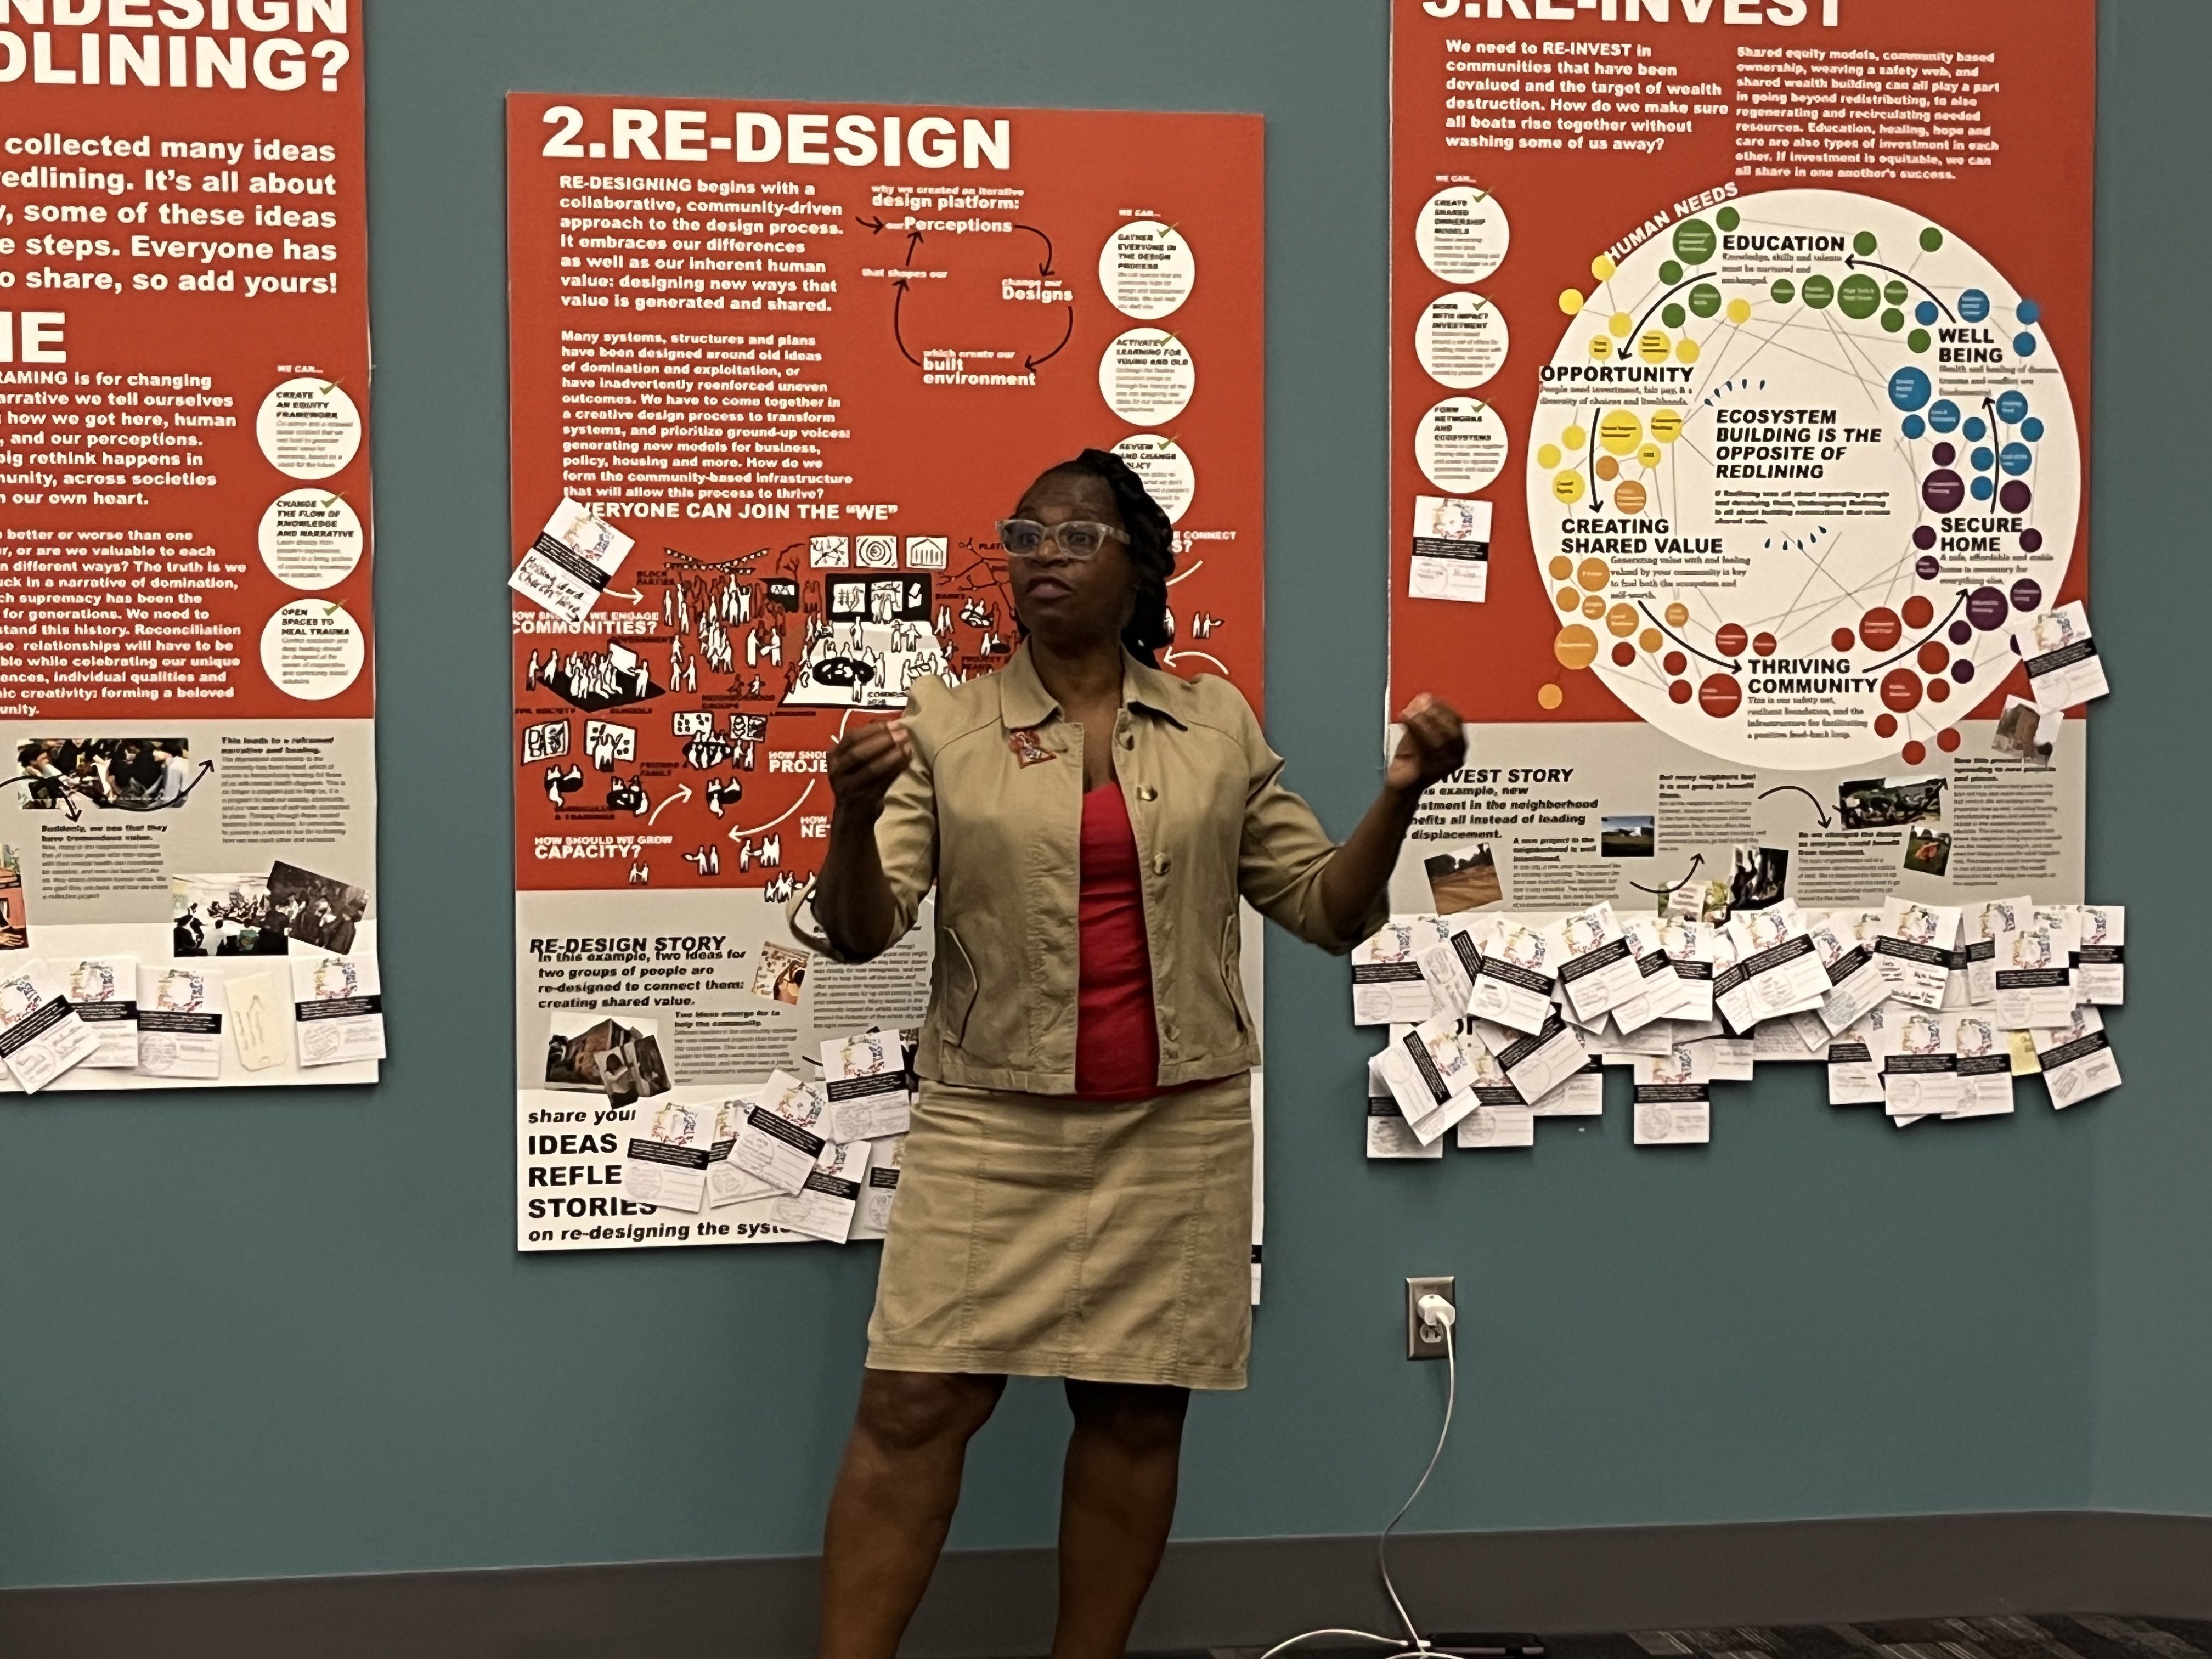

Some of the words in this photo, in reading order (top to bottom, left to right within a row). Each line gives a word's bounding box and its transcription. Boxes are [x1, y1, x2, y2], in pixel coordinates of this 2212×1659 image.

[1446, 39, 1471, 53] We
[1476, 41, 1516, 54] need
[1521, 42, 1538, 54] to
[1543, 41, 1632, 57] RE-INVEST
[1637, 44, 1651, 57] in
[542, 106, 1011, 170] 2.RE-DESIGN
[1967, 126, 1991, 136] and
[5, 133, 150, 157] collected
[161, 142, 244, 165] many
[253, 138, 336, 162] ideas
[1445, 134, 1514, 151] washing
[1519, 138, 1562, 149] some
[1567, 136, 1584, 149] of
[1589, 139, 1608, 150] us
[1612, 137, 1664, 154] away?
[145, 169, 192, 191] It's
[202, 170, 238, 193] all
[249, 172, 336, 195] about
[560, 175, 692, 192] RE-DESIGNING
[697, 179, 756, 196] begins
[760, 180, 799, 195] with
[804, 184, 815, 195] a
[560, 195, 681, 214] collaborative,
[686, 200, 843, 217] community-driven
[872, 194, 933, 212] design
[938, 194, 1019, 211] platform:
[1673, 181, 1739, 218] NEEDS
[24, 205, 108, 223] some
[117, 202, 149, 223] of
[158, 203, 245, 226] these
[255, 205, 337, 228] ideas
[560, 216, 643, 232] approach
[648, 217, 667, 230] to
[672, 217, 701, 232] the
[706, 218, 764, 236] design
[769, 223, 844, 236] process.
[904, 216, 1013, 234] Perceptions
[25, 233, 120, 261] steps.
[131, 235, 273, 263] Everyone
[284, 238, 337, 261] has
[1723, 235, 1845, 251] EDUCATION
[26, 266, 122, 295] share,
[132, 273, 168, 291] so
[178, 270, 234, 292] add
[244, 272, 337, 297] yours!
[561, 293, 609, 307] value
[614, 294, 630, 307] is
[635, 296, 725, 311] generated
[730, 296, 762, 310] and
[767, 297, 832, 312] shared.
[1002, 286, 1074, 304] Designs
[1938, 328, 1994, 344] WELL
[1939, 347, 2003, 363] BEING
[923, 358, 964, 371] built
[923, 372, 1036, 386] environment
[1540, 365, 1695, 383] OPPORTUNITY
[75, 394, 102, 405] we
[108, 392, 138, 406] tell
[143, 393, 233, 407] ourselves
[7, 410, 47, 425] how
[52, 414, 80, 425] we
[84, 412, 116, 428] got
[121, 411, 169, 429] here,
[174, 412, 236, 427] human
[1716, 409, 1837, 425] ECOSYSTEM
[10, 430, 44, 444] and
[50, 434, 82, 444] our
[87, 432, 203, 448] perceptions.
[630, 425, 656, 436] and
[727, 427, 798, 440] ground-up
[1716, 427, 1811, 443] BUILDING
[1818, 428, 1837, 443] IS
[1843, 428, 1882, 443] THE
[1716, 446, 1815, 461] OPPOSITE
[1821, 446, 1847, 461] OF
[63, 474, 126, 485] across
[132, 472, 217, 486] societies
[1716, 464, 1824, 479] REDLINING
[12, 494, 44, 504] our
[48, 494, 87, 505] own
[93, 491, 149, 505] heart.
[686, 503, 731, 518] CAN
[738, 503, 790, 519] JOIN
[796, 504, 840, 520] THE
[1561, 518, 1669, 534] CREATING
[1940, 517, 2023, 533] SECURE
[7, 528, 54, 540] better
[57, 531, 74, 540] or
[127, 529, 161, 540] than
[165, 532, 193, 541] one
[1561, 538, 1647, 554] SHARED
[1654, 538, 1723, 554] VALUE
[1940, 537, 2001, 552] HOME
[590, 611, 608, 620] WE
[1748, 658, 1850, 674] THRIVING
[1748, 678, 1878, 694] COMMUNITY
[1438, 786, 1498, 798] example,
[1502, 787, 1530, 795] new
[1469, 800, 1482, 810] in
[1486, 799, 1506, 810] the
[1510, 799, 1599, 812] neighborhood
[1450, 815, 1466, 825] all
[1470, 814, 1518, 825] instead
[1521, 814, 1535, 824] of
[1538, 814, 1586, 826] leading
[616, 836, 635, 845] WE
[637, 835, 674, 844] GROW
[1411, 829, 1503, 844] displacement.
[534, 845, 642, 859] CAPACITY?
[529, 938, 648, 953] RE-DESIGN
[654, 936, 727, 952] STORY
[538, 968, 565, 978] two
[568, 968, 617, 980] groups
[621, 966, 636, 977] of
[639, 965, 687, 978] people
[691, 967, 714, 975] are
[538, 997, 597, 1010] creating
[601, 996, 650, 1007] shared
[528, 1109, 587, 1124] share
[528, 1133, 617, 1155] IDEAS
[528, 1230, 554, 1242] on
[561, 1223, 690, 1242] re-designing
[697, 1221, 730, 1236] the
